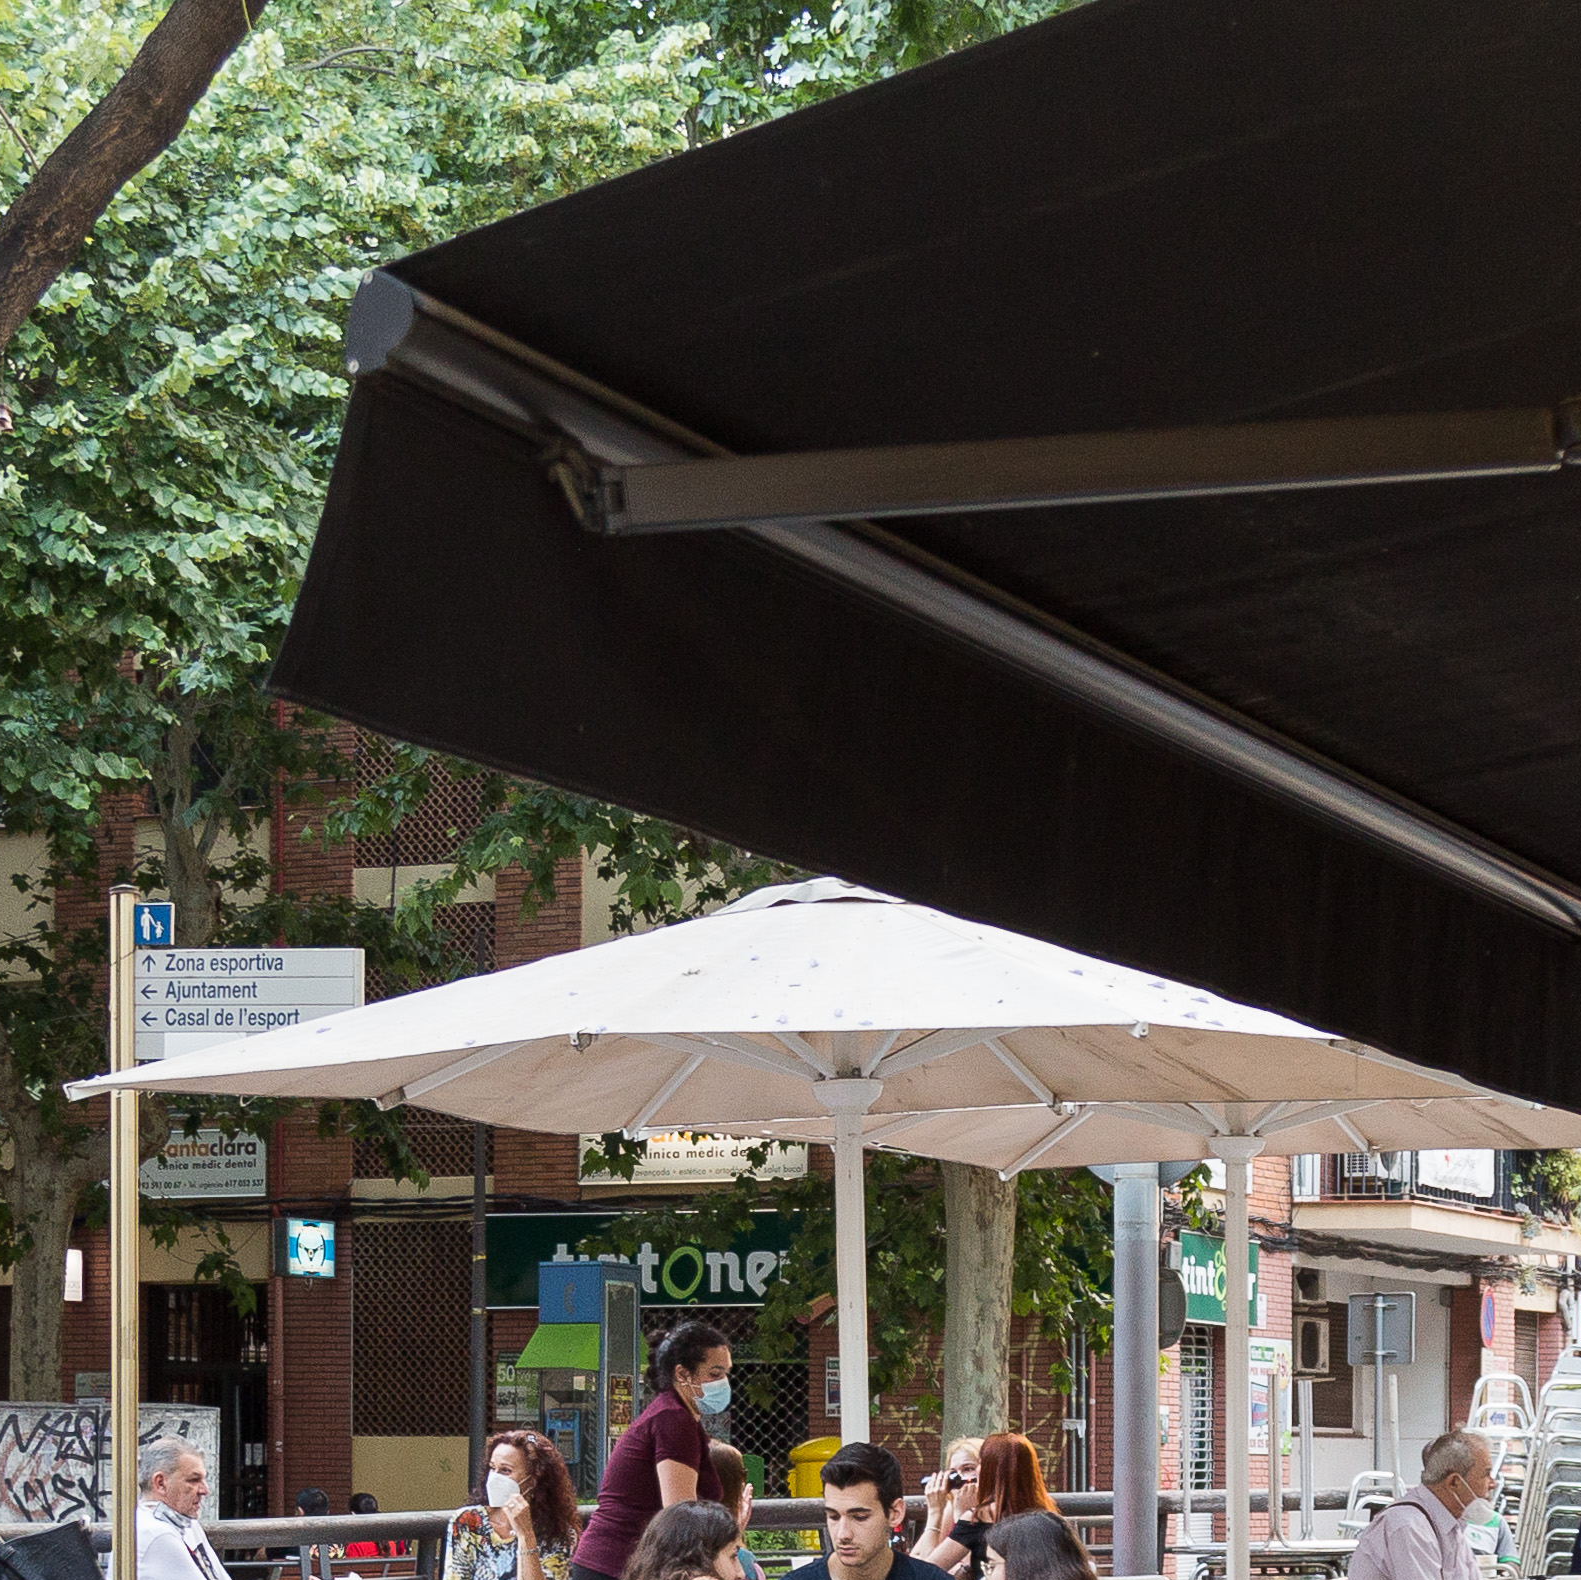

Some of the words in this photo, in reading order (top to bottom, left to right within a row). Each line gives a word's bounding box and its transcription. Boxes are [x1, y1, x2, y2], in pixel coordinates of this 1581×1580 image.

[165, 953, 205, 972] Zona
[210, 953, 284, 975] esportiva
[165, 980, 258, 1003] Ajuntament
[165, 1008, 209, 1027] Casal
[214, 1009, 234, 1027] de
[239, 1008, 300, 1034] l'esport
